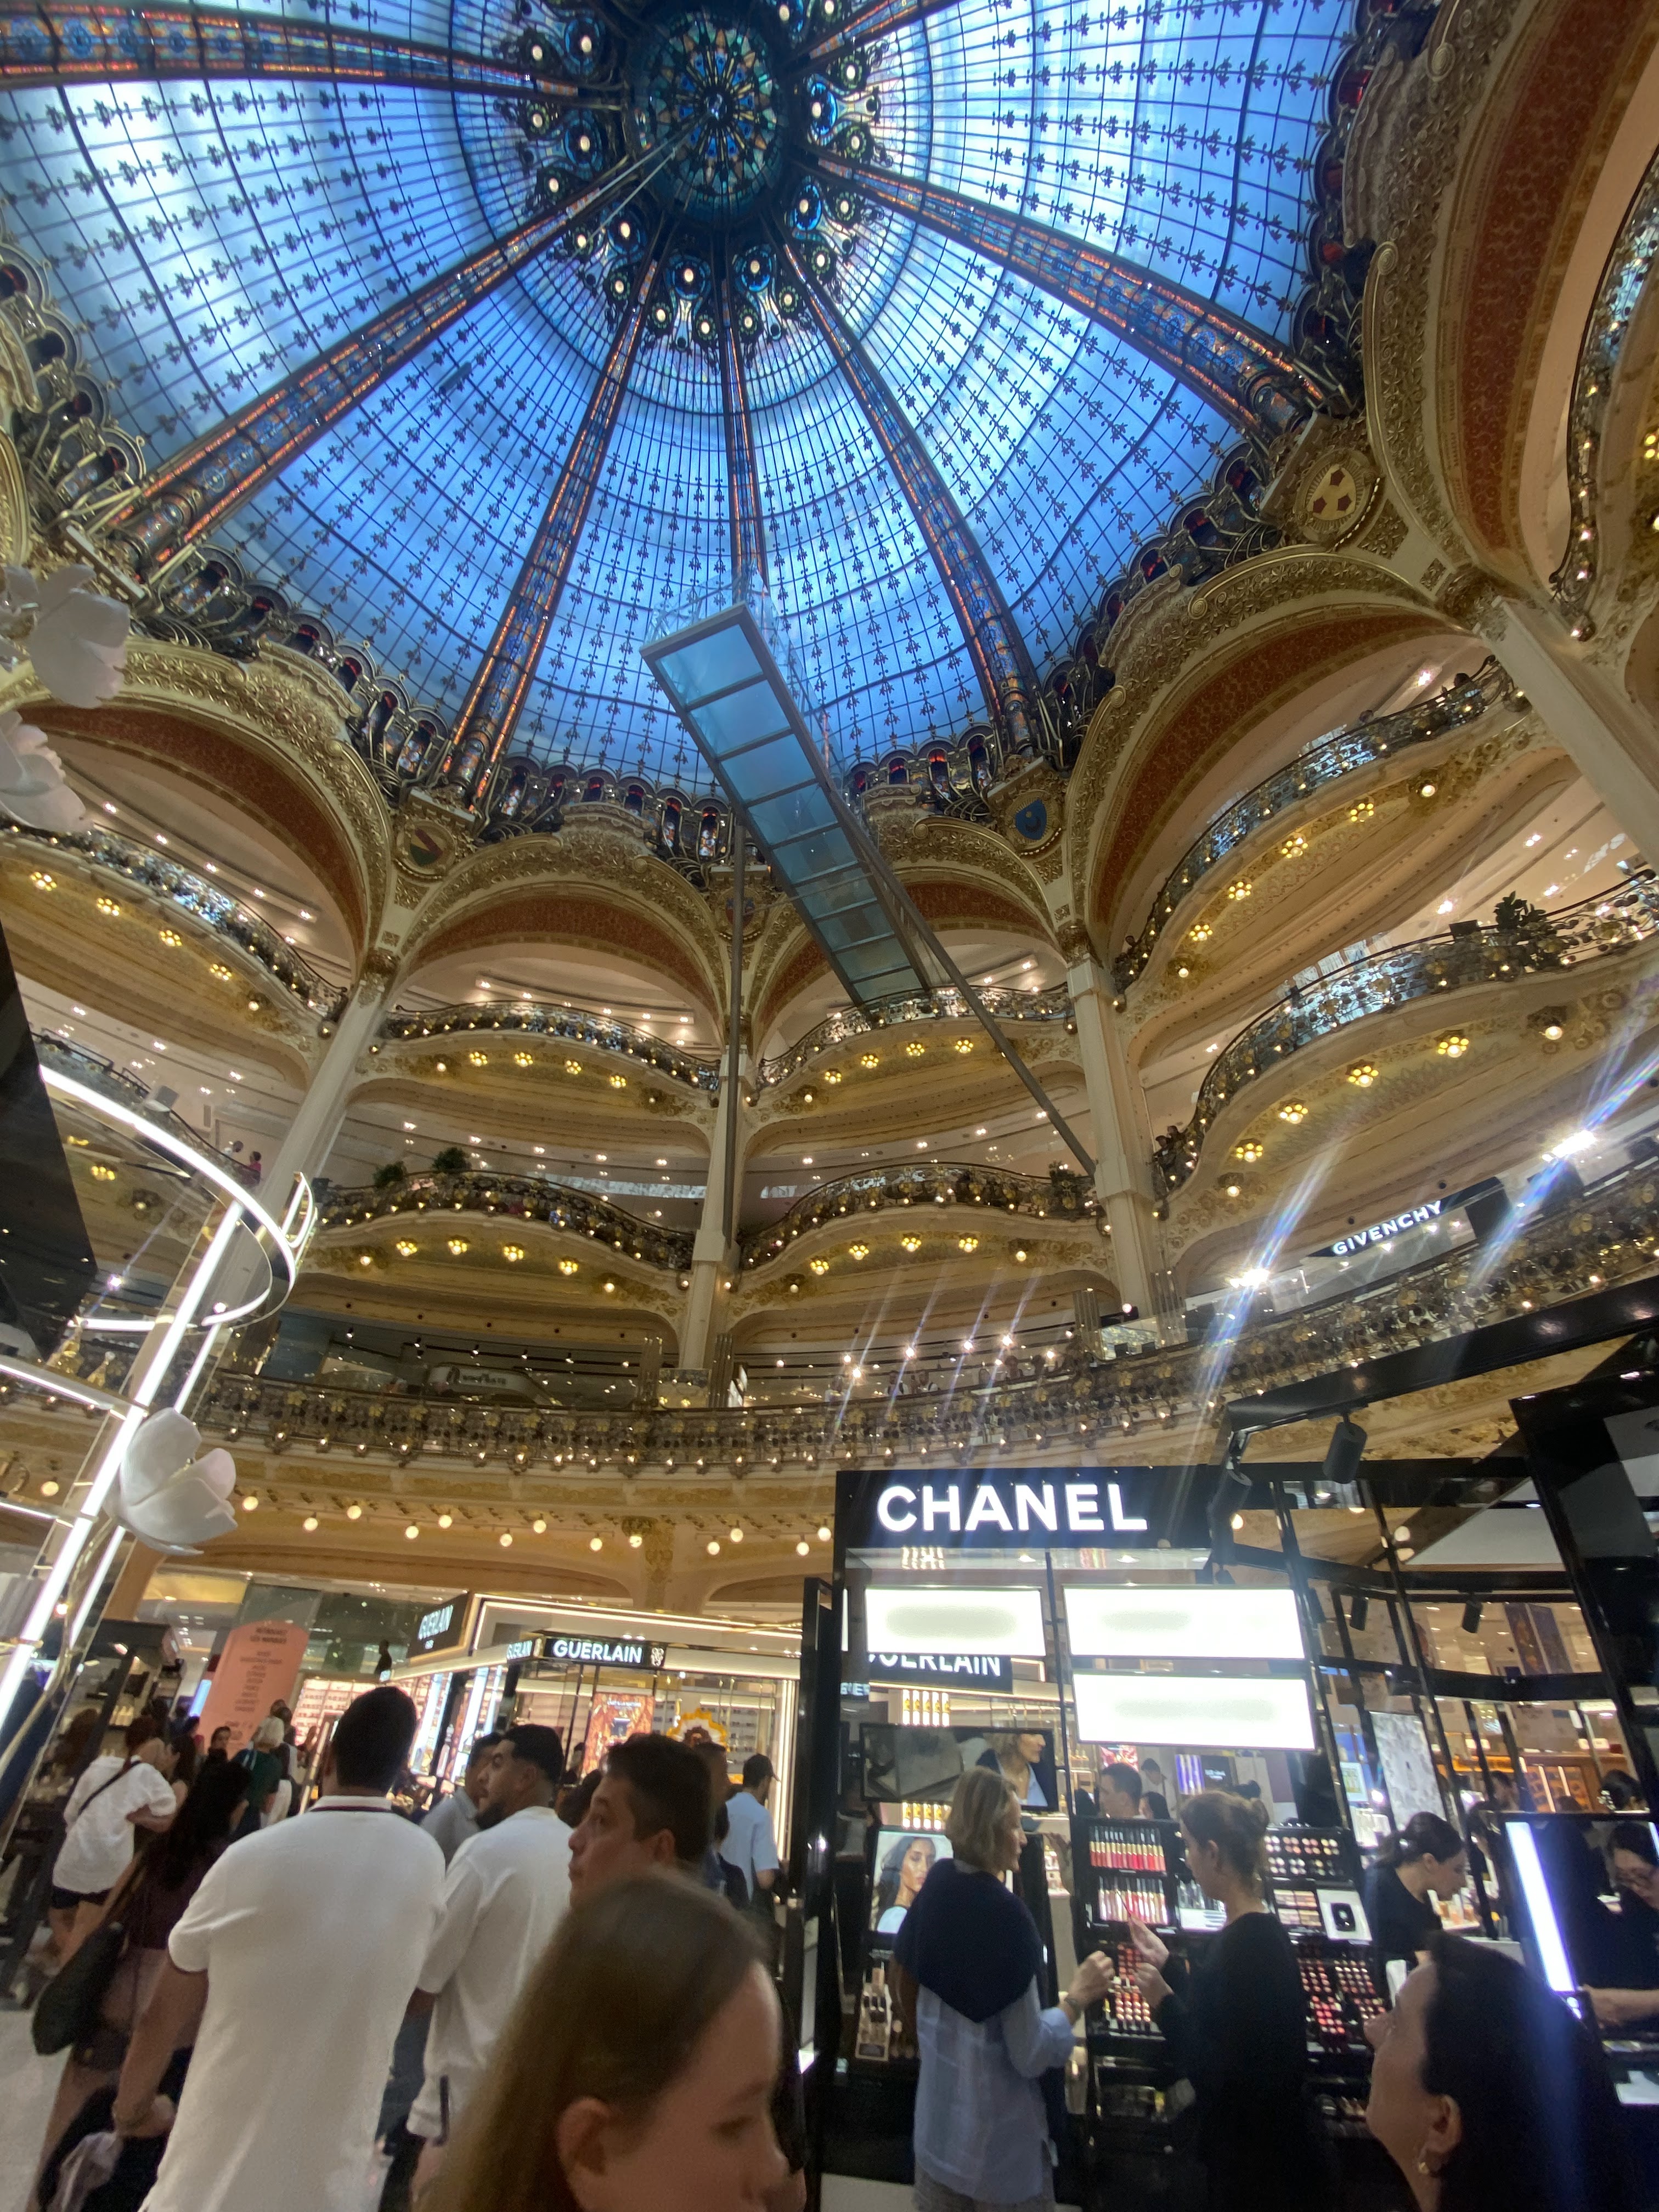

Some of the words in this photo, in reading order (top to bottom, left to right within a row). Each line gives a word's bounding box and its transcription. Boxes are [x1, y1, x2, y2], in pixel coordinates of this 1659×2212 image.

[1332, 1200, 1442, 1256] GIVENCHY
[877, 1483, 1148, 1532] CHANEL
[553, 1639, 642, 1664] GUERLAIN
[868, 1654, 1001, 1677] UERLAIN
